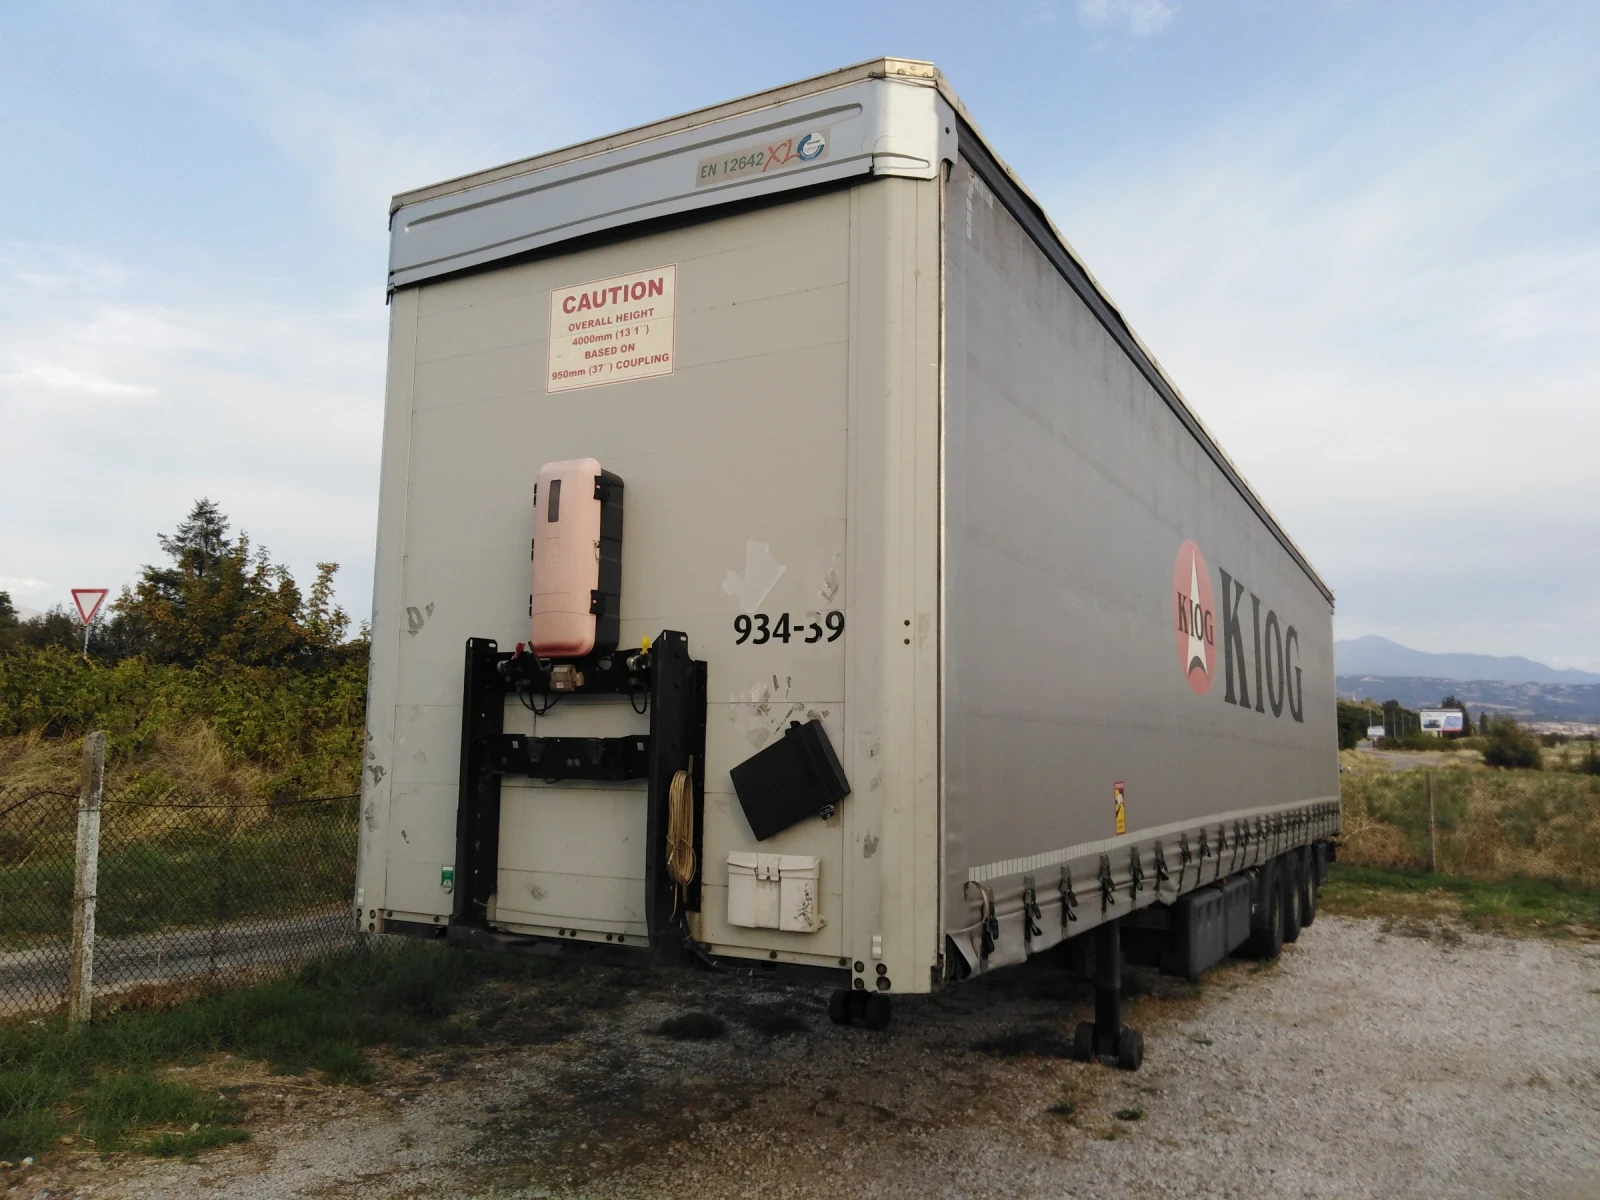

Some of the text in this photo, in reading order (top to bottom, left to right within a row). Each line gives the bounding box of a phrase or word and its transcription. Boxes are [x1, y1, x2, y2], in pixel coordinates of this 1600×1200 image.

[700, 164, 717, 179] EN
[723, 152, 765, 174] 12642
[762, 138, 800, 173] XL
[562, 277, 664, 315] CAUTION
[568, 307, 655, 332] OVERALL HEIGHT
[571, 332, 613, 346] 4000mm
[584, 343, 636, 360] BASED ON
[551, 368, 586, 380] 950mm
[615, 353, 670, 370] COUPLING
[1177, 591, 1214, 647] KIOG
[1218, 566, 1304, 724] KIOG
